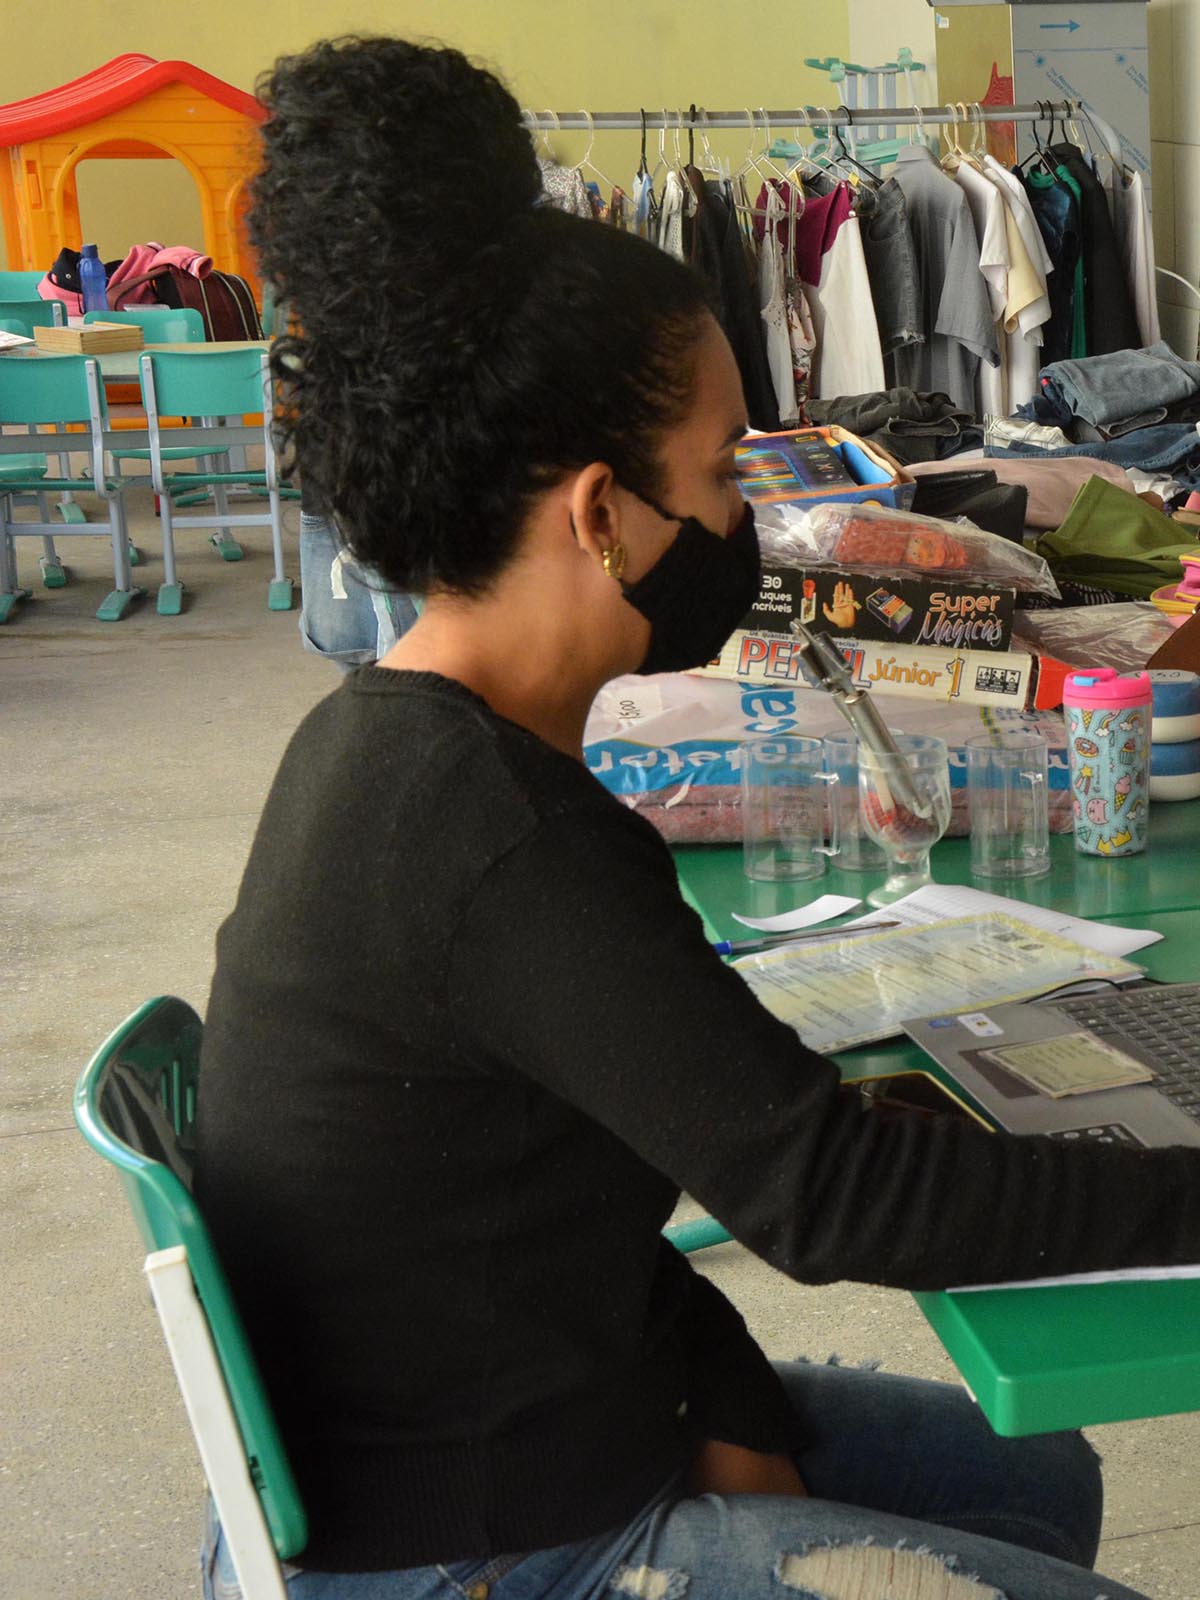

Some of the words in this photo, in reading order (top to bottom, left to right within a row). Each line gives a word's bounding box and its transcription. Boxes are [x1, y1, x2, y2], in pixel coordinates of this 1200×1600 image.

[762, 575, 783, 589] 30
[759, 591, 793, 602] uques
[929, 591, 1001, 618] Super
[751, 601, 793, 614] ncríveis
[913, 610, 1004, 650] Mágicas
[867, 656, 942, 688] Júnior
[945, 657, 965, 697] 1
